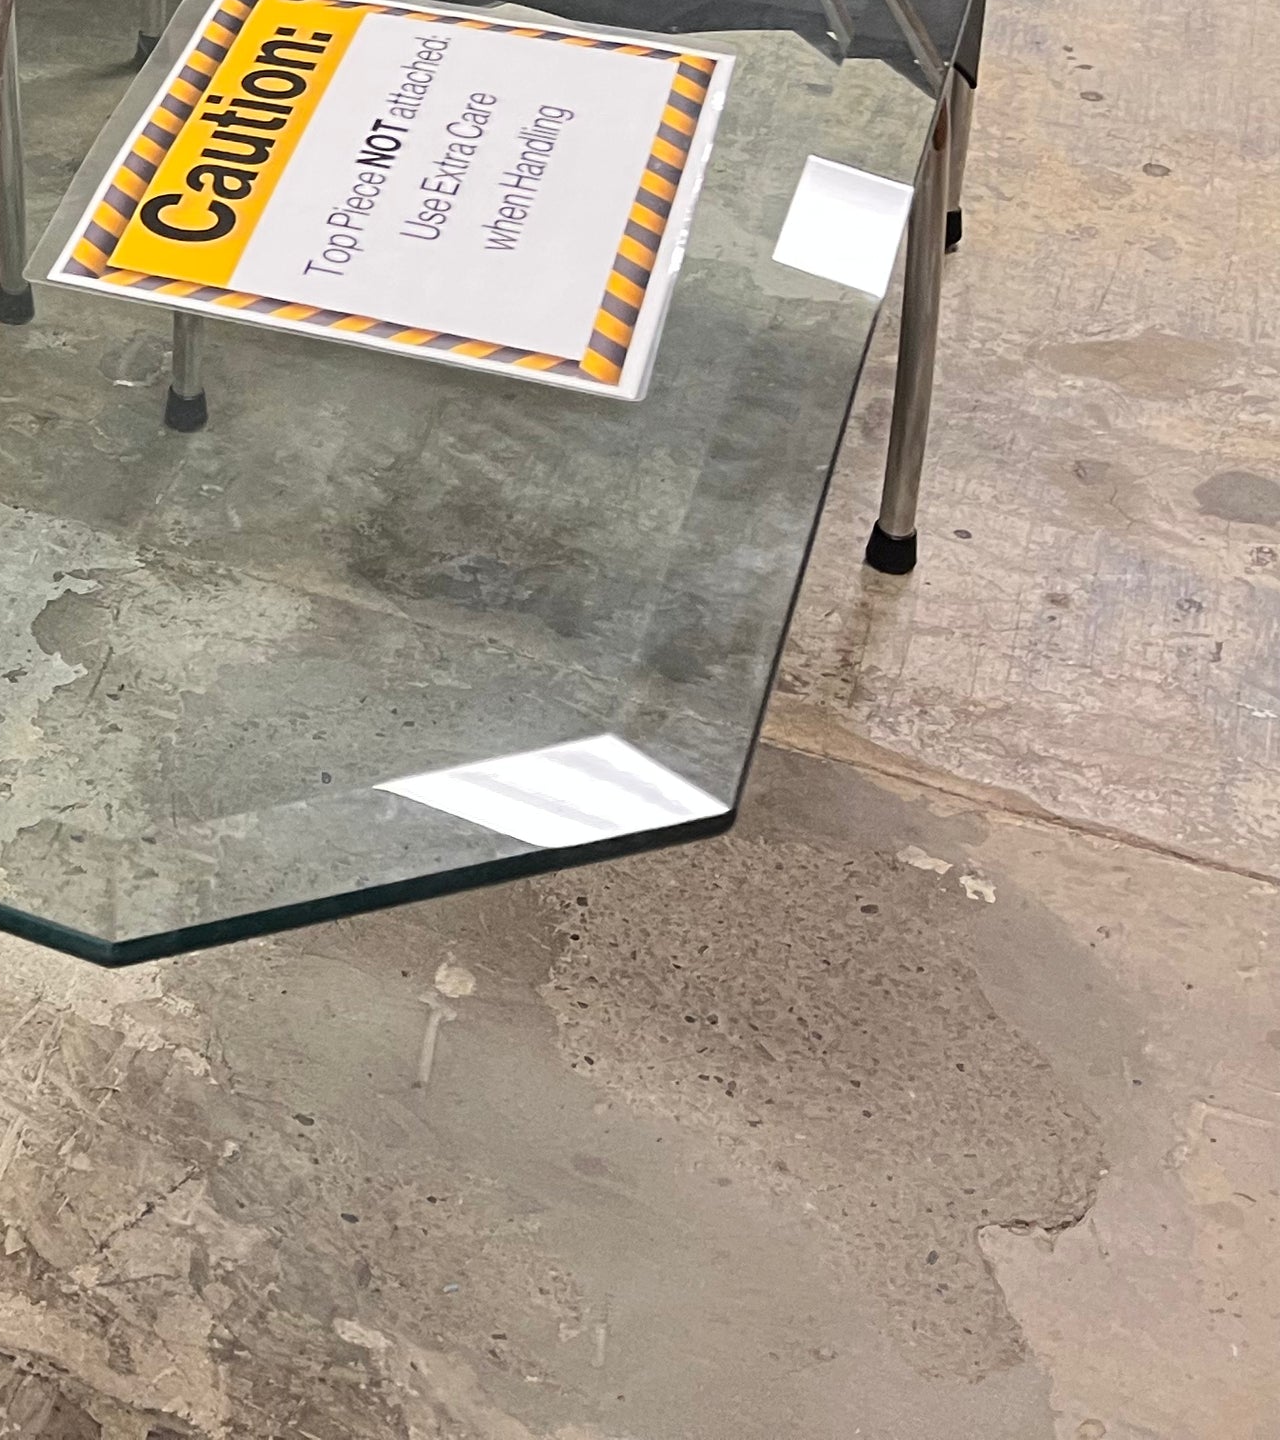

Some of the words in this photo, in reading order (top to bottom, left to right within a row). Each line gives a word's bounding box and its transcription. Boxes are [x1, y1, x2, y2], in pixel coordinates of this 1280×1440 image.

[139, 26, 333, 243] Caution:
[445, 91, 499, 139] Care
[354, 118, 410, 170] NOT
[419, 142, 479, 197] Extra
[498, 104, 576, 192] Handling
[326, 170, 387, 231] Piece
[399, 198, 453, 241] Use
[481, 193, 534, 250] when
[303, 232, 364, 277] Top
